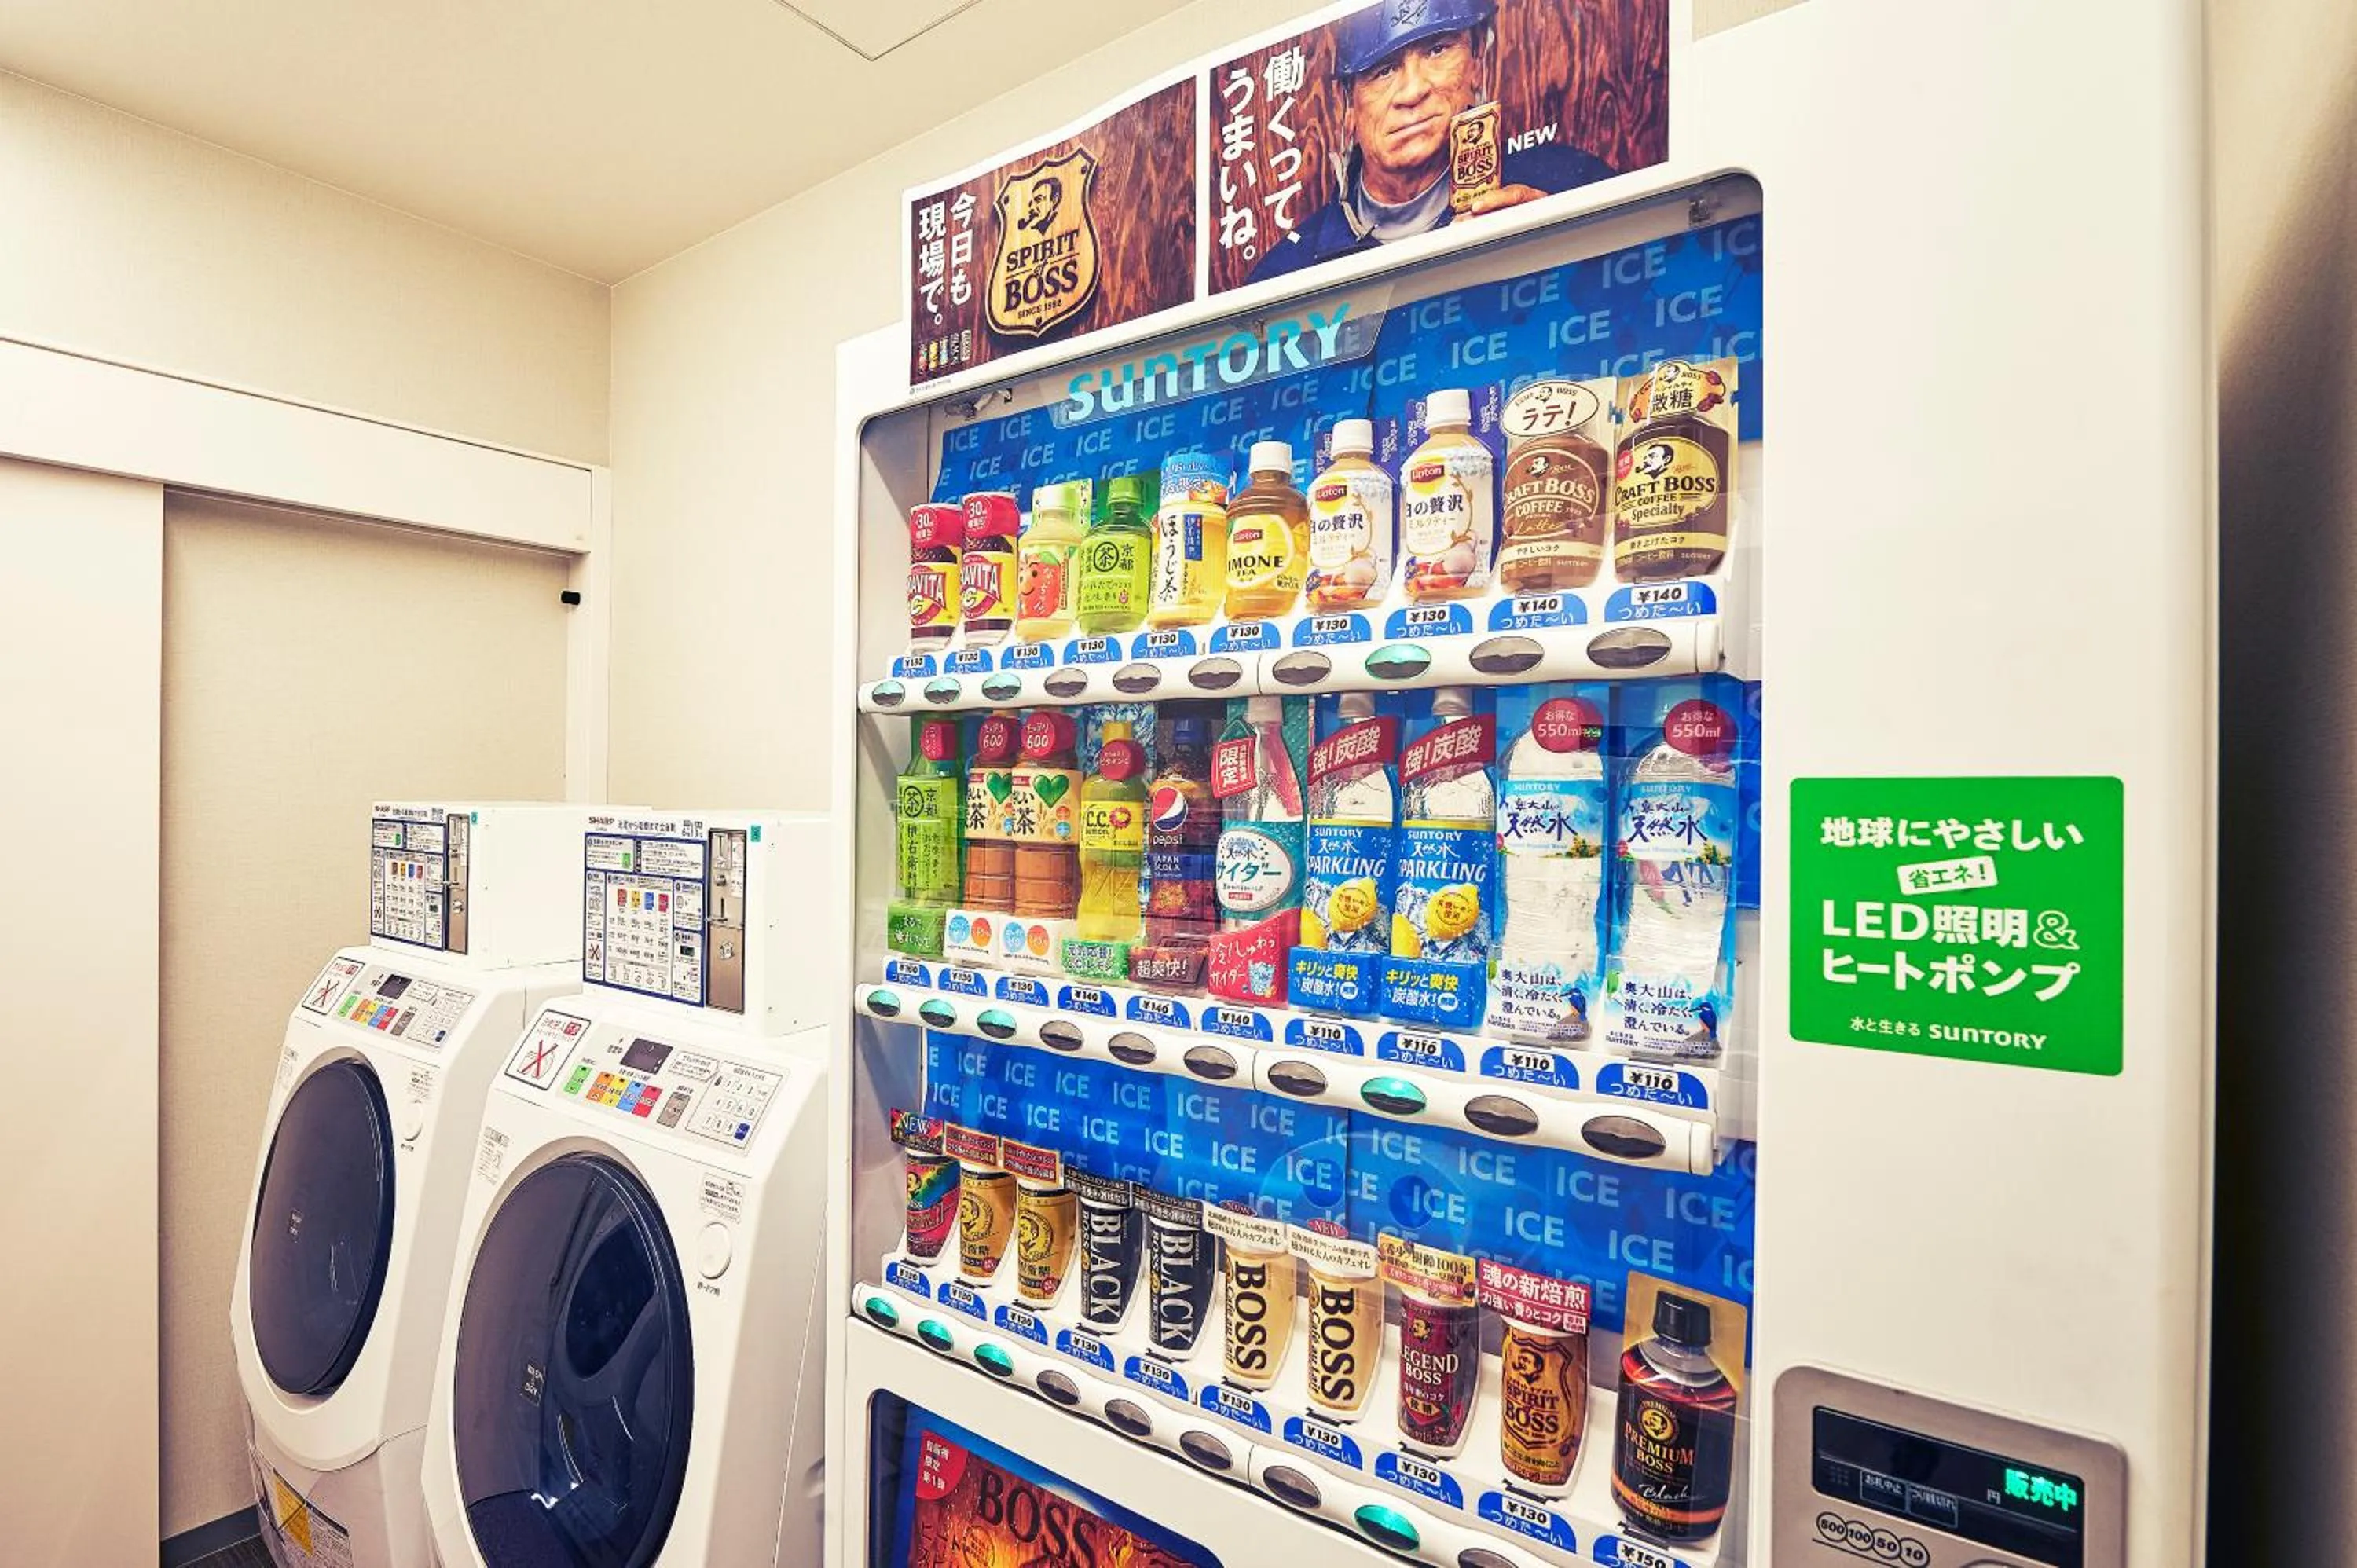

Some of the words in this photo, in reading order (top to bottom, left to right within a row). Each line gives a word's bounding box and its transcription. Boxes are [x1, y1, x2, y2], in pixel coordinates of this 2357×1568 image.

[1263, 46, 1306, 244] 働くって、
[1508, 123, 1558, 155] NEW
[1219, 69, 1257, 261] うまいね。
[1457, 145, 1494, 165] SPIRIT
[1457, 157, 1494, 181] BOSS
[950, 192, 977, 307] 今日も
[1006, 230, 1080, 273] SPIRIT
[918, 200, 947, 326] 現場で。
[1004, 259, 1080, 313] BOSS
[1501, 273, 1560, 312] ICE
[1018, 304, 1043, 321] SINCE
[1411, 295, 1461, 335] ICE
[1452, 332, 1508, 370] ICE
[1066, 303, 1351, 423] SUNTORY
[1201, 398, 1244, 428] ICE
[999, 416, 1032, 441] ICE
[1412, 466, 1442, 481] Lipton
[1318, 485, 1344, 500] Lipton
[1508, 480, 1543, 504] RAFT
[1545, 478, 1595, 504] BOSS
[1615, 481, 1660, 507] CRAFT
[1664, 475, 1716, 493] BOSS
[1637, 494, 1677, 507] COFFEE
[968, 500, 984, 518] 30
[1516, 500, 1563, 518] COFFEE
[1632, 503, 1684, 522] Specialty
[916, 512, 930, 529] 30
[1234, 529, 1261, 542] Lipton
[1098, 544, 1115, 570] 茶
[1119, 542, 1135, 572] 京都
[1159, 515, 1178, 603] ほうじ茶
[1228, 555, 1285, 573] IMONE
[1236, 569, 1257, 577] TEA
[1519, 598, 1558, 612] ¥140
[1638, 588, 1683, 603] ¥140
[1315, 619, 1347, 631] ¥130
[1410, 610, 1446, 622] ¥130
[1150, 634, 1177, 645] ¥130
[1230, 626, 1259, 637] ¥130
[1016, 647, 1039, 657] ¥130
[1080, 640, 1105, 652] ¥130
[1545, 709, 1576, 722] お得な
[1681, 711, 1714, 722] お得な
[983, 735, 1004, 747] 600
[1538, 724, 1582, 738] 550ml
[1672, 724, 1721, 738] 550ml
[1027, 735, 1049, 749] 600
[1404, 724, 1482, 776] 強!炭酸
[1219, 746, 1239, 787] 限定
[1514, 782, 1561, 792] SUNTORY
[588, 816, 615, 825] SHARP
[1086, 810, 1110, 828] C.C.
[1504, 812, 1578, 841] 天然水
[1315, 828, 1364, 838] SUNTORY
[1407, 830, 1463, 841] SUNTORY
[1628, 814, 1709, 846] 天然水
[1820, 816, 2084, 851] 地球にやさしい
[1153, 834, 1182, 847] pepsi
[1318, 838, 1360, 854] 天然水
[1411, 842, 1461, 858] 天然水
[1217, 862, 1282, 884] サイダー
[1309, 855, 1387, 877] PARKLING
[1399, 859, 1487, 883] PARKLING
[1908, 863, 1988, 889] 省エネ!
[1821, 899, 2080, 950] LED照明&
[1137, 958, 1188, 978] 超爽快!
[1210, 965, 1246, 987] サイダー
[1296, 960, 1358, 980] キリッと爽快
[1501, 969, 1562, 986] 奥大山は、
[1822, 948, 2081, 1002] ヒートポンプ
[1010, 980, 1034, 993] ¥130
[1299, 976, 1340, 998] 炭酸水!
[1385, 969, 1459, 991] キリッと爽快
[1074, 990, 1099, 1002] ¥140
[1391, 987, 1437, 1007] 炭酸水!
[1501, 985, 1563, 1003] 清く、冷たく、
[1625, 981, 1692, 1000] 奥大山は、
[1142, 1000, 1169, 1014] ¥140
[1502, 1002, 1561, 1020] 澄んでいる。
[1624, 998, 1692, 1018] 清く、冷たく、
[1222, 1011, 1251, 1026] ¥140
[1624, 1016, 1690, 1036] 澄んでいる。
[1310, 1024, 1342, 1039] ¥110
[1849, 1016, 1921, 1037] 水と生きる
[1929, 1023, 2047, 1050] SUNTORY
[1402, 1037, 1437, 1055] ¥110
[958, 1051, 987, 1077] ICE
[1512, 1052, 1550, 1071] ¥110
[1630, 1069, 1673, 1090] ¥110
[1027, 1102, 1061, 1132] ICE
[1178, 1093, 1220, 1124] ICE
[904, 1114, 930, 1134] NEW
[1287, 1155, 1332, 1192] ICE
[1666, 1188, 1736, 1232] ICE
[1314, 1220, 1339, 1236] NEW
[1090, 1213, 1121, 1318] BLACK
[1160, 1232, 1193, 1344] BLACK
[1483, 1262, 1587, 1311] 魂の新焙煎
[1235, 1261, 1267, 1370] BOSS
[1482, 1291, 1563, 1324] 力強い香りとコク
[1073, 1337, 1098, 1353] ¥130
[1321, 1284, 1355, 1401] BOSS
[1143, 1365, 1171, 1380] ¥130
[1405, 1362, 1443, 1385] BOSS
[1220, 1393, 1252, 1412] ¥130
[1507, 1383, 1559, 1410] SPIRIT
[1505, 1401, 1559, 1434] BOSS
[1307, 1425, 1340, 1445] ¥130
[1625, 1421, 1695, 1467] PREMIUM
[1637, 1449, 1674, 1474] BOSS
[1401, 1461, 1438, 1483] ¥130
[1986, 1489, 2002, 1506] 円
[2004, 1468, 2078, 1511] 販売中
[980, 1470, 1096, 1568] BOSS
[1506, 1501, 1548, 1524] ¥130
[1820, 1517, 1846, 1536] 500
[1848, 1525, 1872, 1544] 100
[1875, 1537, 1898, 1553] 50
[1904, 1545, 1923, 1561] 10
[1622, 1544, 1666, 1568] ¥150
